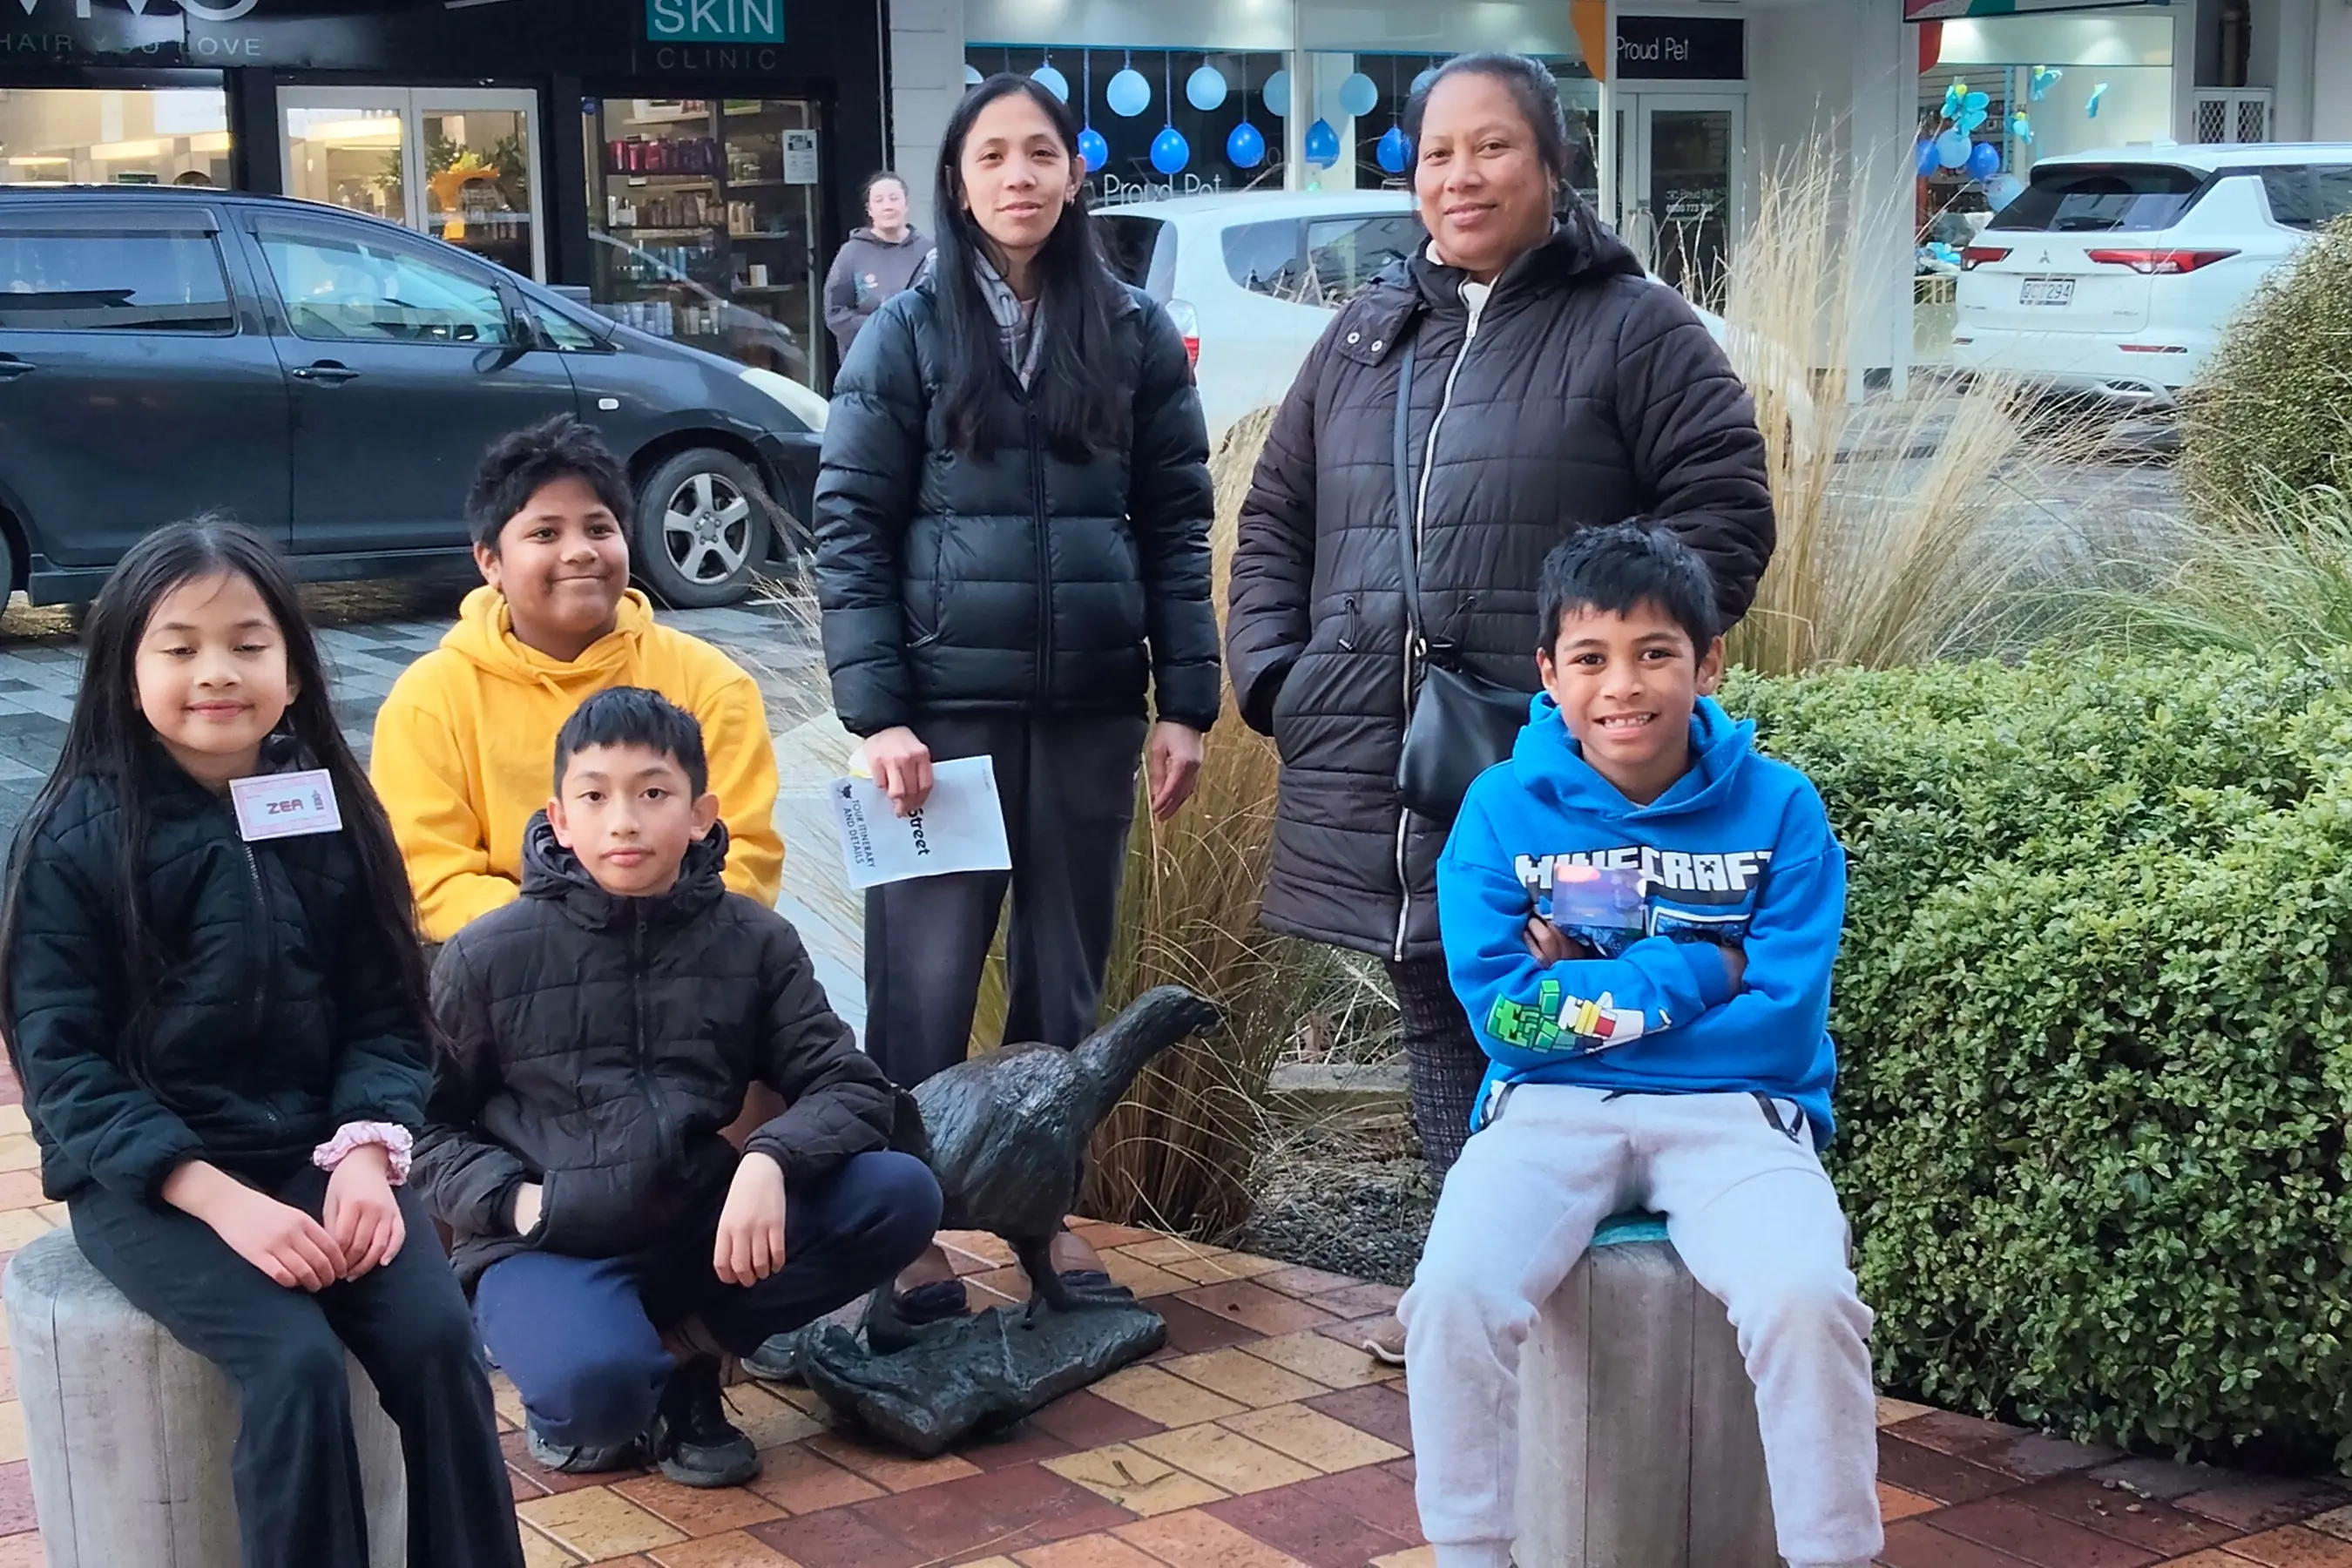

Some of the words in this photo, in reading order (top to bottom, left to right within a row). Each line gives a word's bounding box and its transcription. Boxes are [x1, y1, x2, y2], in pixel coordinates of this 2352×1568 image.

[653, 0, 774, 34] SKIN
[656, 47, 776, 70] CLINIC
[1616, 36, 1659, 60] Proud
[266, 799, 304, 814] ZEA
[843, 808, 855, 828] AND
[852, 800, 864, 821] TOUR
[858, 824, 875, 868] ITINERARY
[848, 830, 865, 864] DETAILS
